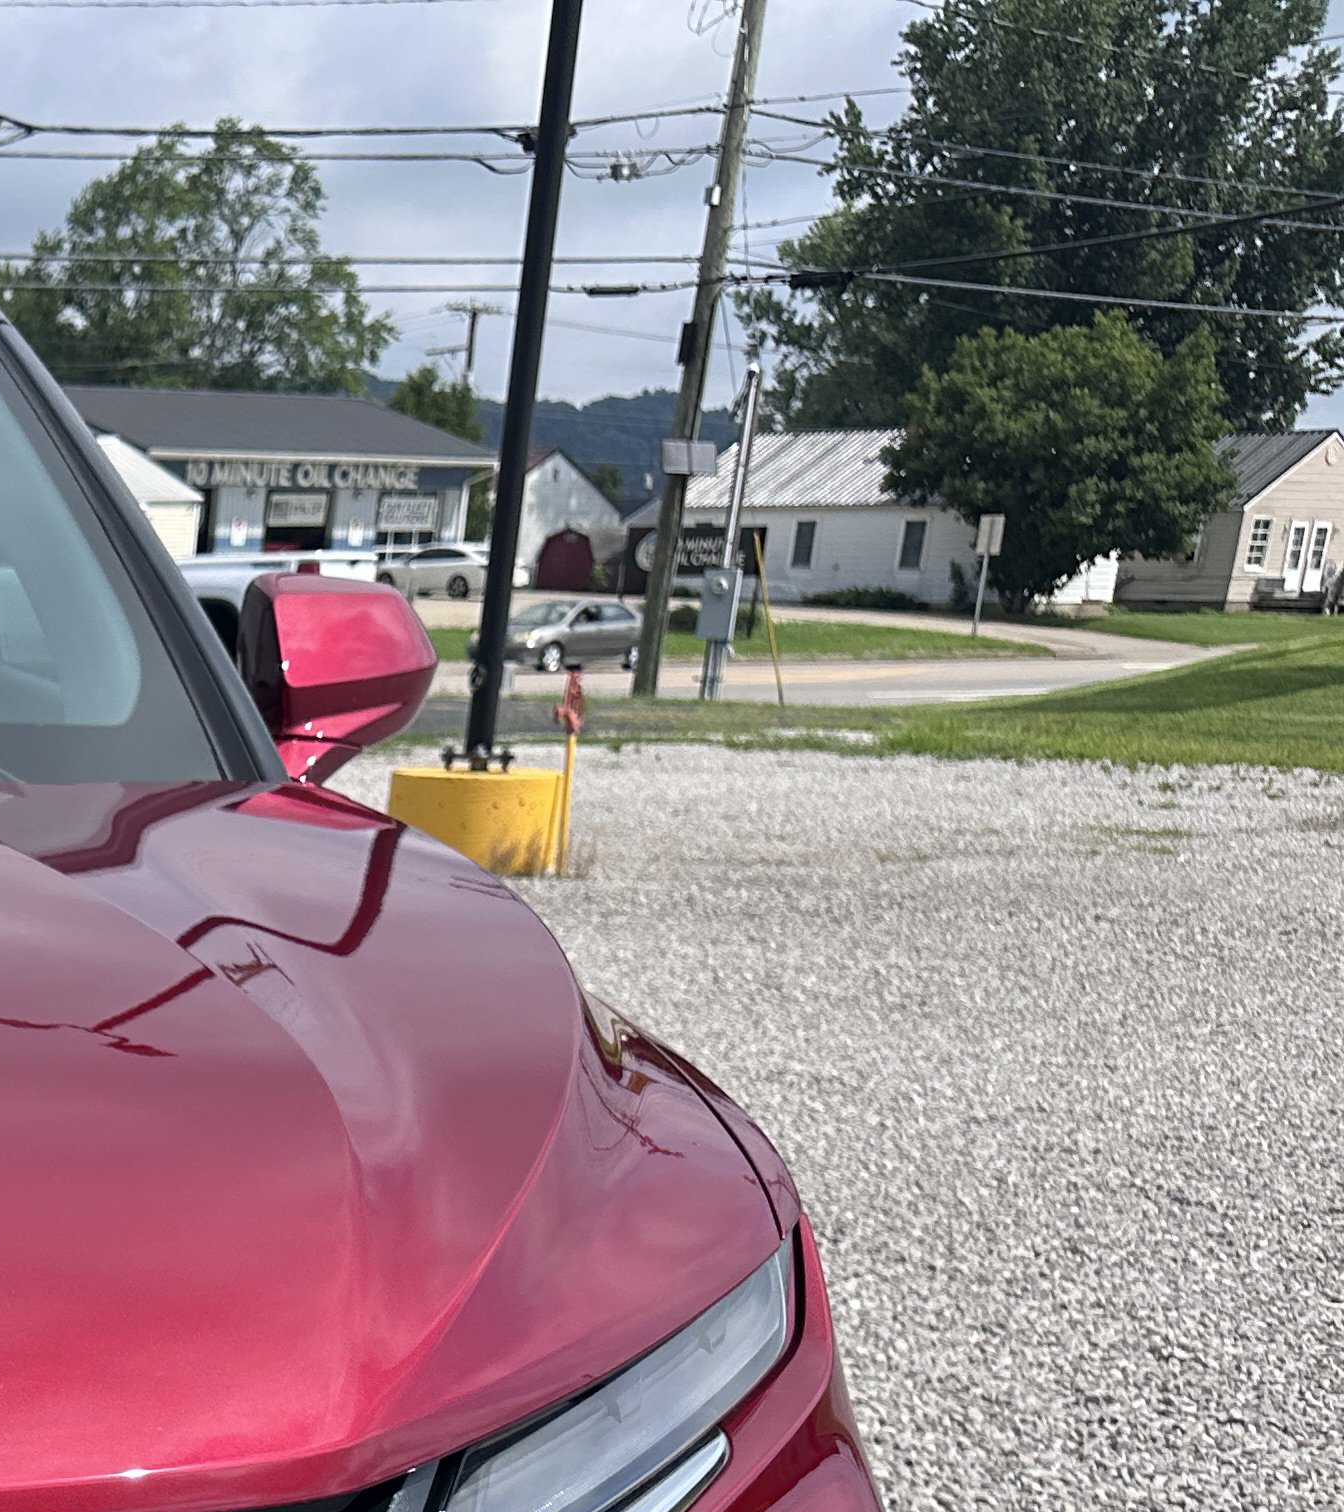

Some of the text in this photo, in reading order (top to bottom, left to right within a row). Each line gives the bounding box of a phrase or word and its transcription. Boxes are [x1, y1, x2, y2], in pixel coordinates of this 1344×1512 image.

[187, 462, 420, 490] 10 MINUTE OIL CHANGE
[685, 536, 727, 551] MINUT
[690, 551, 746, 566] CHANE
